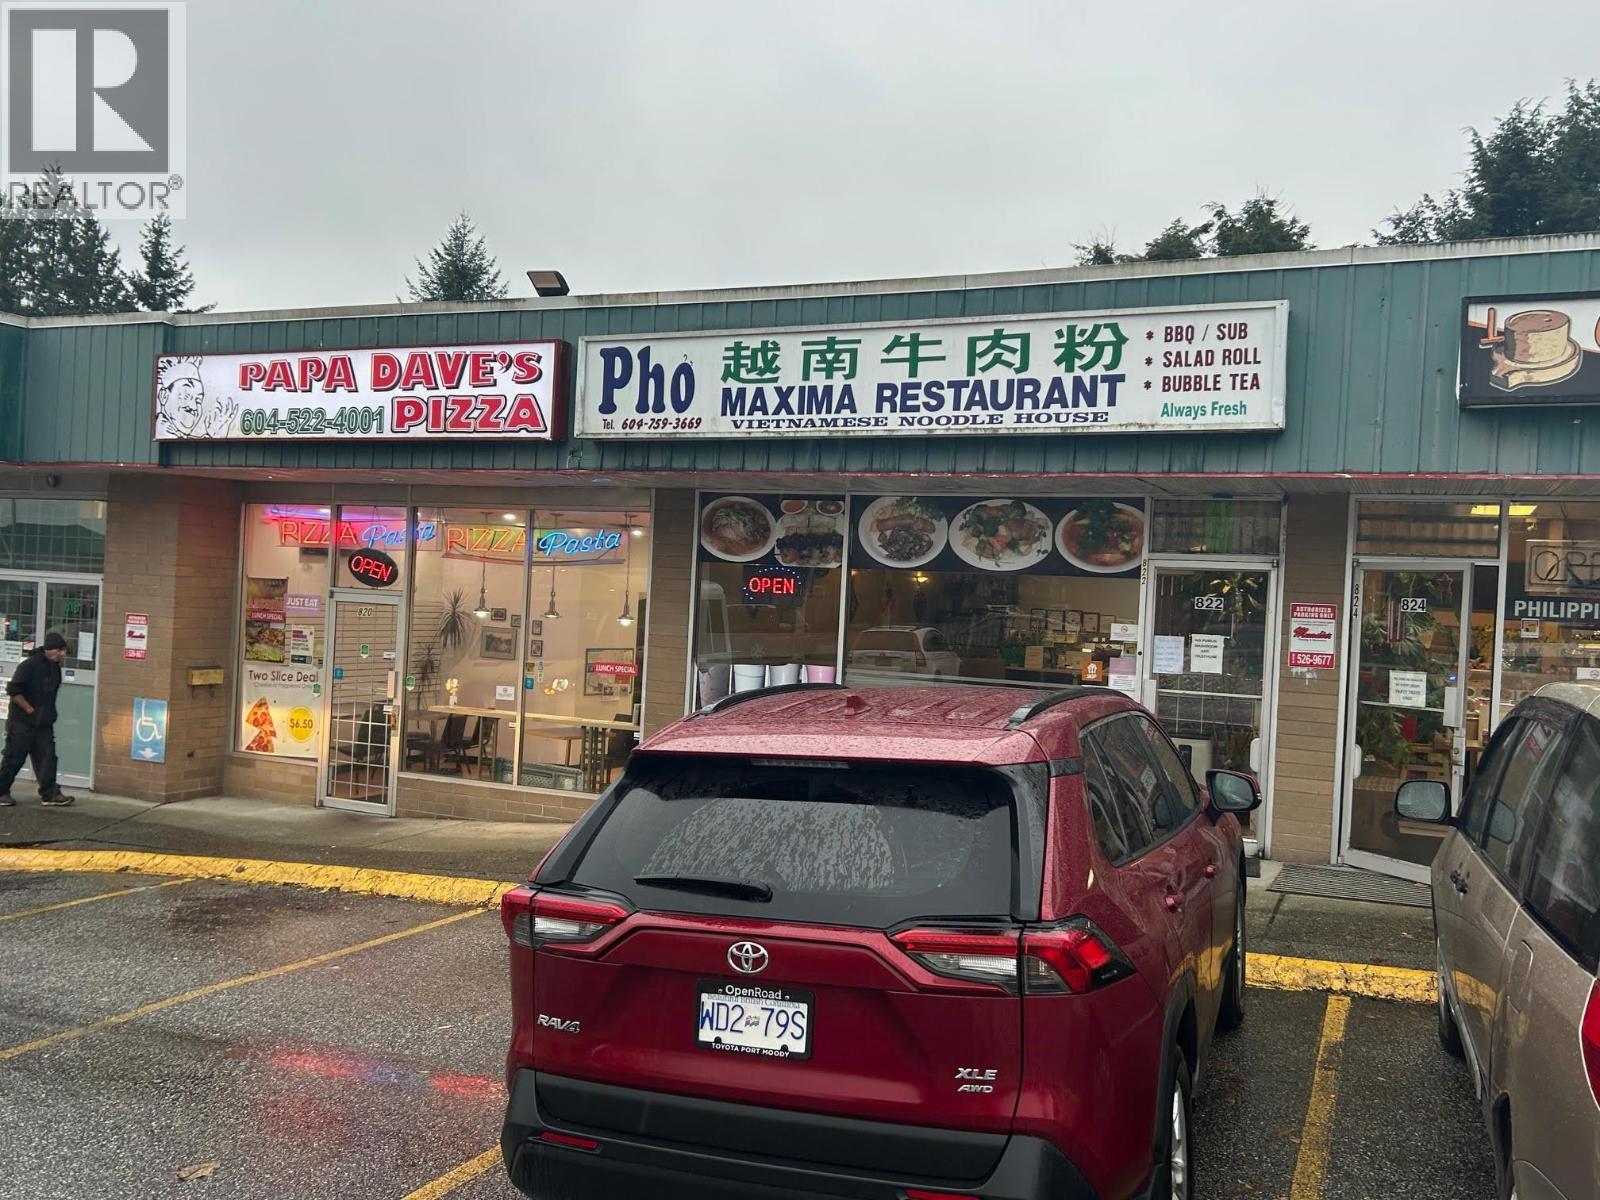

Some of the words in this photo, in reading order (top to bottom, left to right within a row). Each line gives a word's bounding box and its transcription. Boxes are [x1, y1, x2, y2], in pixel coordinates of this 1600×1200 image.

[1164, 325, 1195, 344] BBQ
[1216, 323, 1248, 340] SUB
[721, 322, 1129, 385] 越南牛肉粉
[1162, 350, 1215, 368] SALAD
[1222, 347, 1262, 366] ROLL
[239, 354, 357, 393] PAPA
[371, 351, 543, 391] DAVE'S
[1162, 374, 1222, 392] BUBBLE
[1230, 373, 1260, 390] TEA
[721, 383, 857, 417] MAXIMA
[875, 373, 1126, 413] RESTAURANT
[391, 394, 547, 433] PIZZA
[1161, 402, 1207, 420] Always
[1211, 401, 1247, 416] Fresh
[239, 406, 384, 435] 604-522-4001
[603, 418, 615, 430] Tel.
[621, 417, 702, 430] 604-759-3669
[731, 416, 888, 429] VIETNAMESE
[898, 414, 1004, 427] NOODLE
[1013, 411, 1109, 424] HOUSE
[538, 529, 622, 556] Pasta
[351, 555, 392, 582] OPEN
[749, 577, 795, 594] OPEN
[286, 598, 303, 606] JUST
[305, 599, 319, 607] EAT
[1195, 598, 1223, 609] 822
[1353, 583, 1361, 618] 824
[1401, 599, 1426, 611] 824
[358, 607, 373, 617] 820
[1297, 653, 1332, 666] 526-9677
[248, 670, 268, 680] Two
[271, 671, 294, 682] Slice
[296, 671, 319, 683] Deal
[595, 664, 614, 672] LUNCH
[615, 665, 636, 674] SPECIAL
[289, 718, 313, 729] $6.50
[725, 985, 781, 1000] OpenRoad
[537, 1014, 581, 1034] RAV4
[700, 1001, 744, 1033] WD2
[761, 1007, 805, 1040] 79S
[711, 1042, 739, 1053] TOYOTA
[741, 1046, 760, 1055] PORT
[762, 1049, 790, 1058] MOODY
[955, 1067, 998, 1080] XLE
[957, 1084, 993, 1094] AWD
